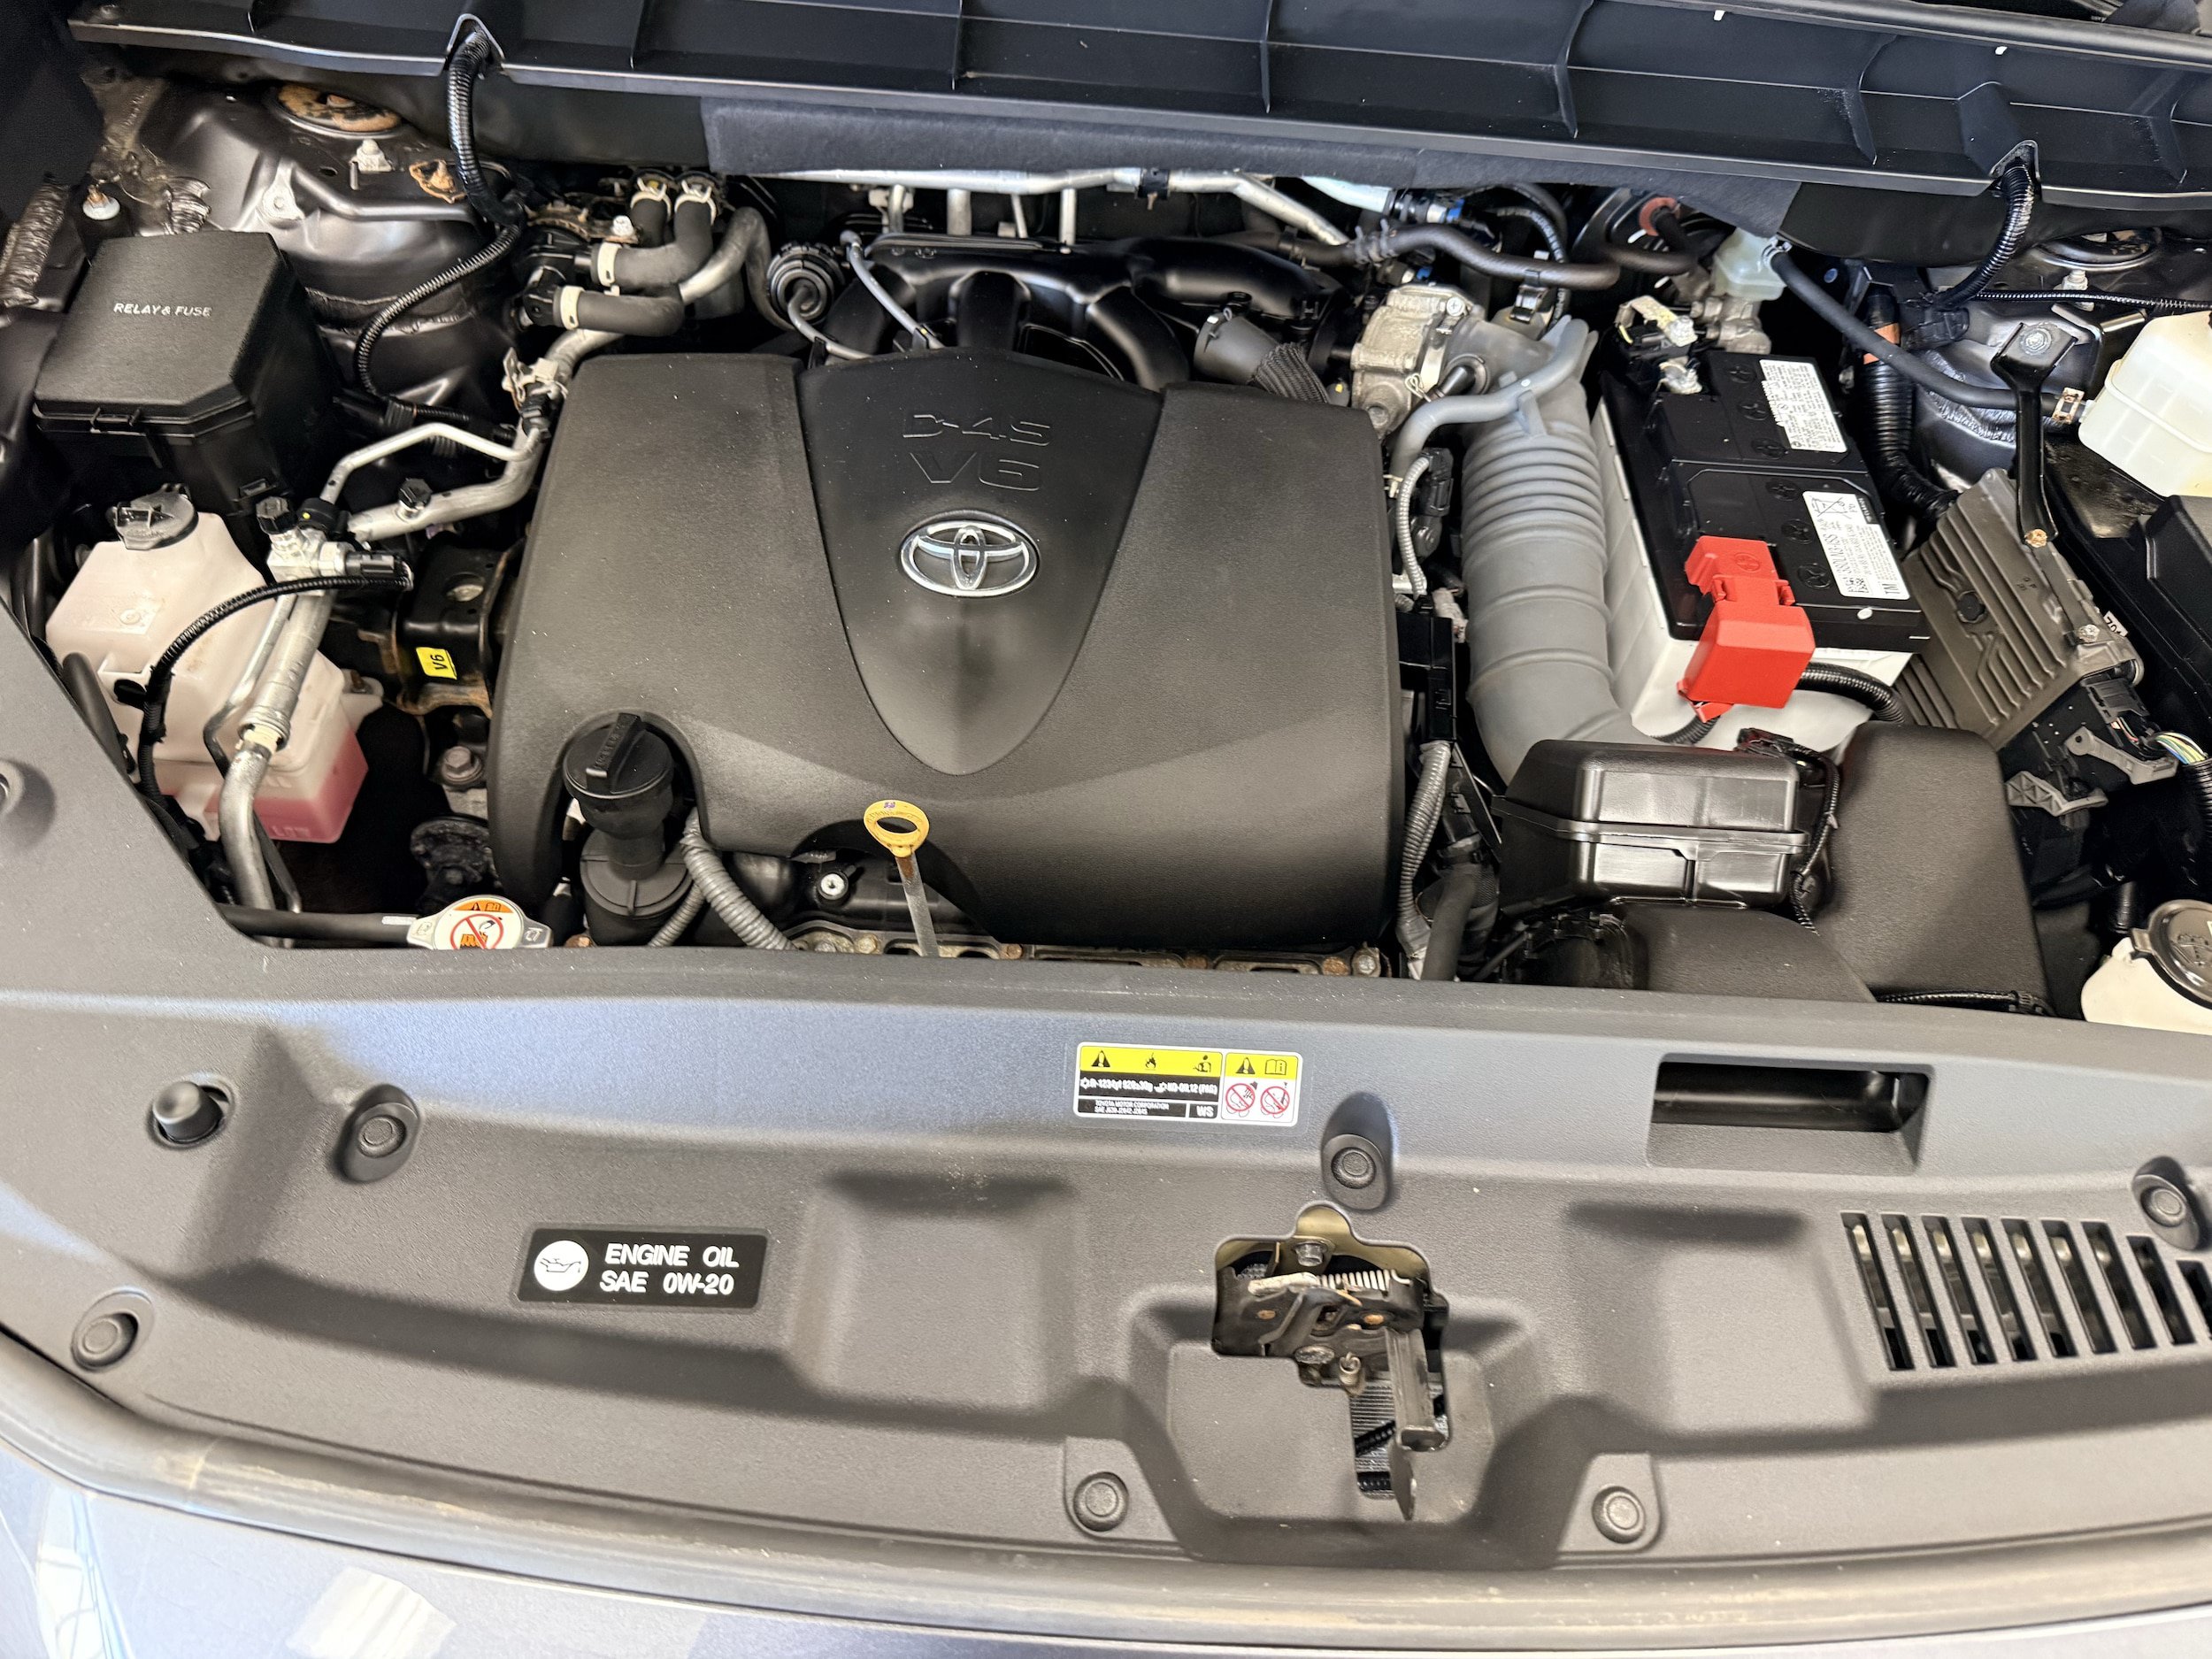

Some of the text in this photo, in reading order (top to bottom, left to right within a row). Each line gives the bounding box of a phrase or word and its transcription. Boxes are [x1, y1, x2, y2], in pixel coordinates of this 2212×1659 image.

[174, 305, 212, 317] FUSE
[902, 413, 1051, 447] D-4S
[909, 450, 1041, 492] V6
[430, 654, 448, 671] V6
[1196, 1105, 1214, 1118] WS
[603, 1242, 740, 1268] ENGINE OIL
[599, 1271, 735, 1295] SAE 0W-20
